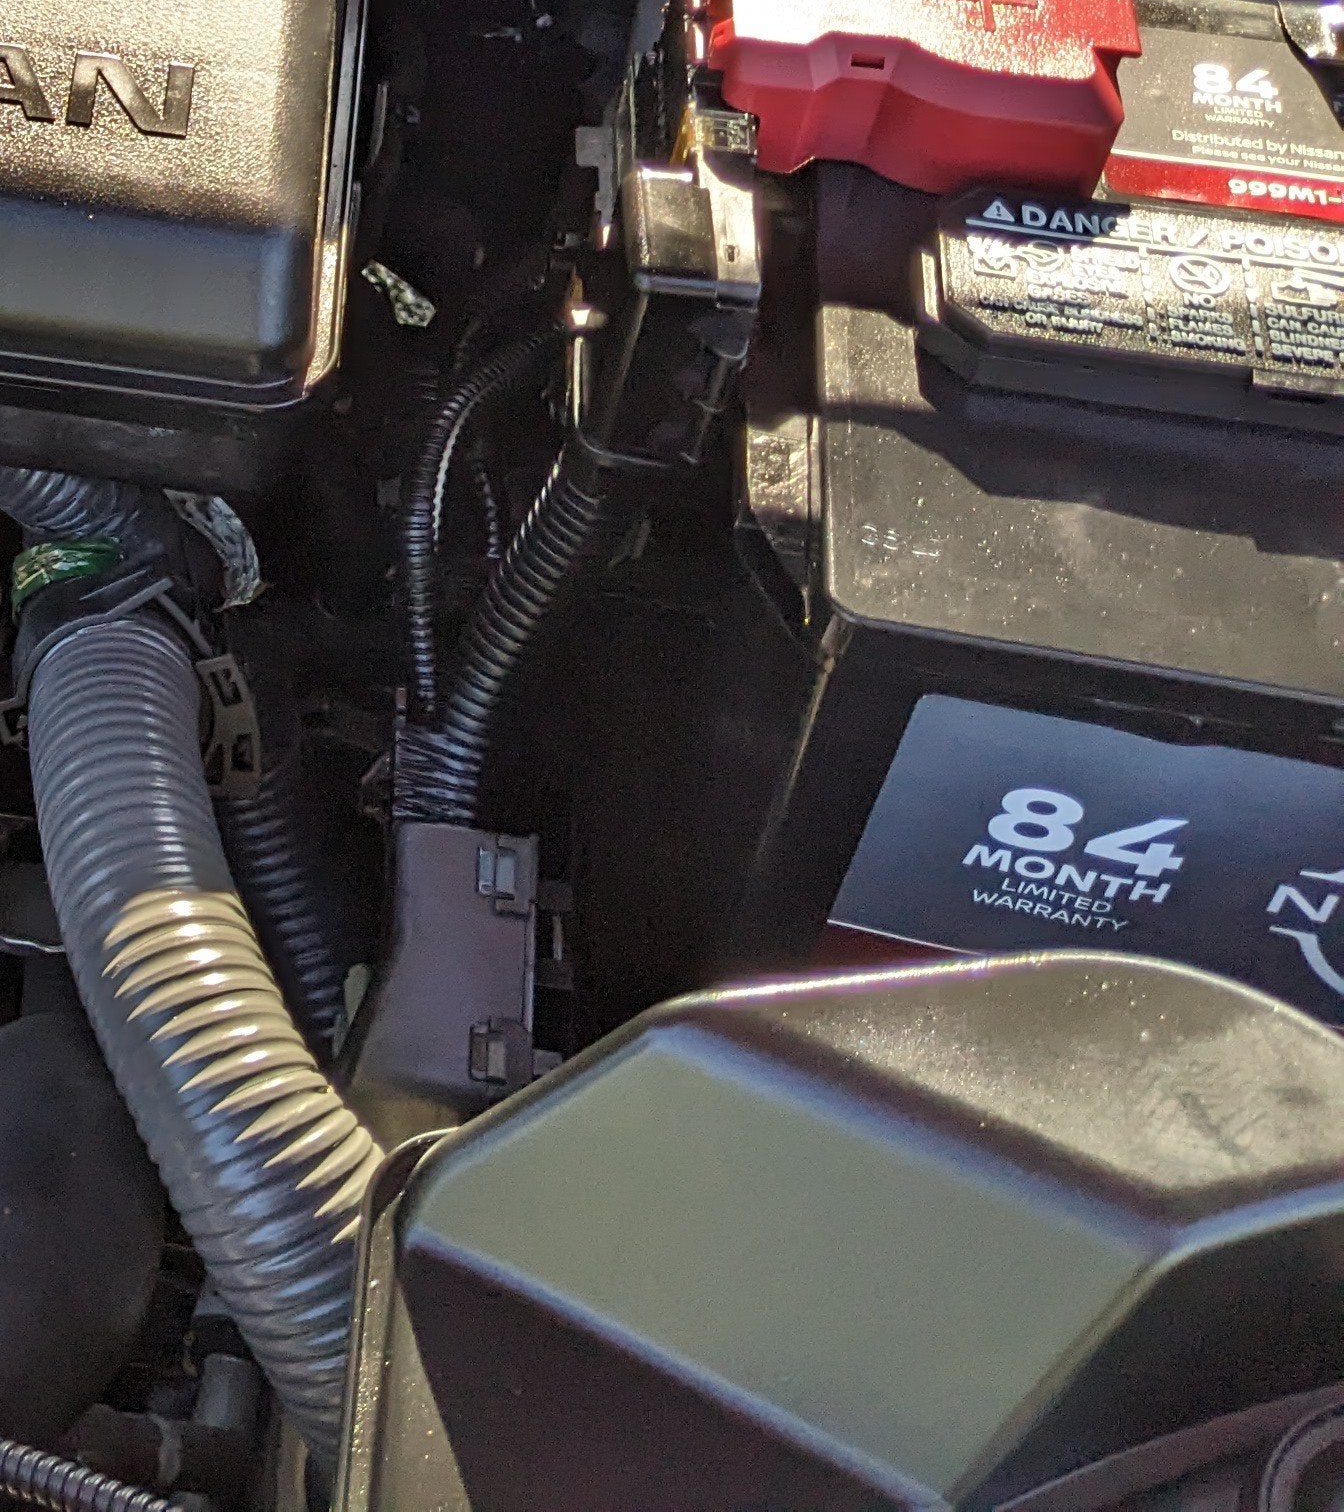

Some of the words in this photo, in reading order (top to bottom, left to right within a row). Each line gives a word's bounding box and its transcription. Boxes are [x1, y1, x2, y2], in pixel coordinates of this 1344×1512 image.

[1192, 62, 1279, 100] 84
[1192, 91, 1283, 114] MONTH
[1213, 106, 1264, 118] LIMITED
[1204, 113, 1275, 128] WARRANTY
[1171, 129, 1263, 150] Distributed
[1266, 139, 1288, 155] by
[1192, 145, 1239, 159] Please
[1241, 152, 1266, 162] see
[1268, 155, 1301, 166] your
[1021, 203, 1178, 246] DANGER
[1220, 230, 1344, 265] POISO
[1183, 292, 1217, 308] NO
[1167, 305, 1234, 324] SPARKS
[1267, 317, 1302, 332] CAN
[1169, 317, 1234, 336] FLAMES
[987, 786, 1190, 878] 84
[962, 843, 1172, 904] MONTH
[1001, 877, 1112, 914] LIMITED
[973, 888, 1129, 931] WARRANTY
